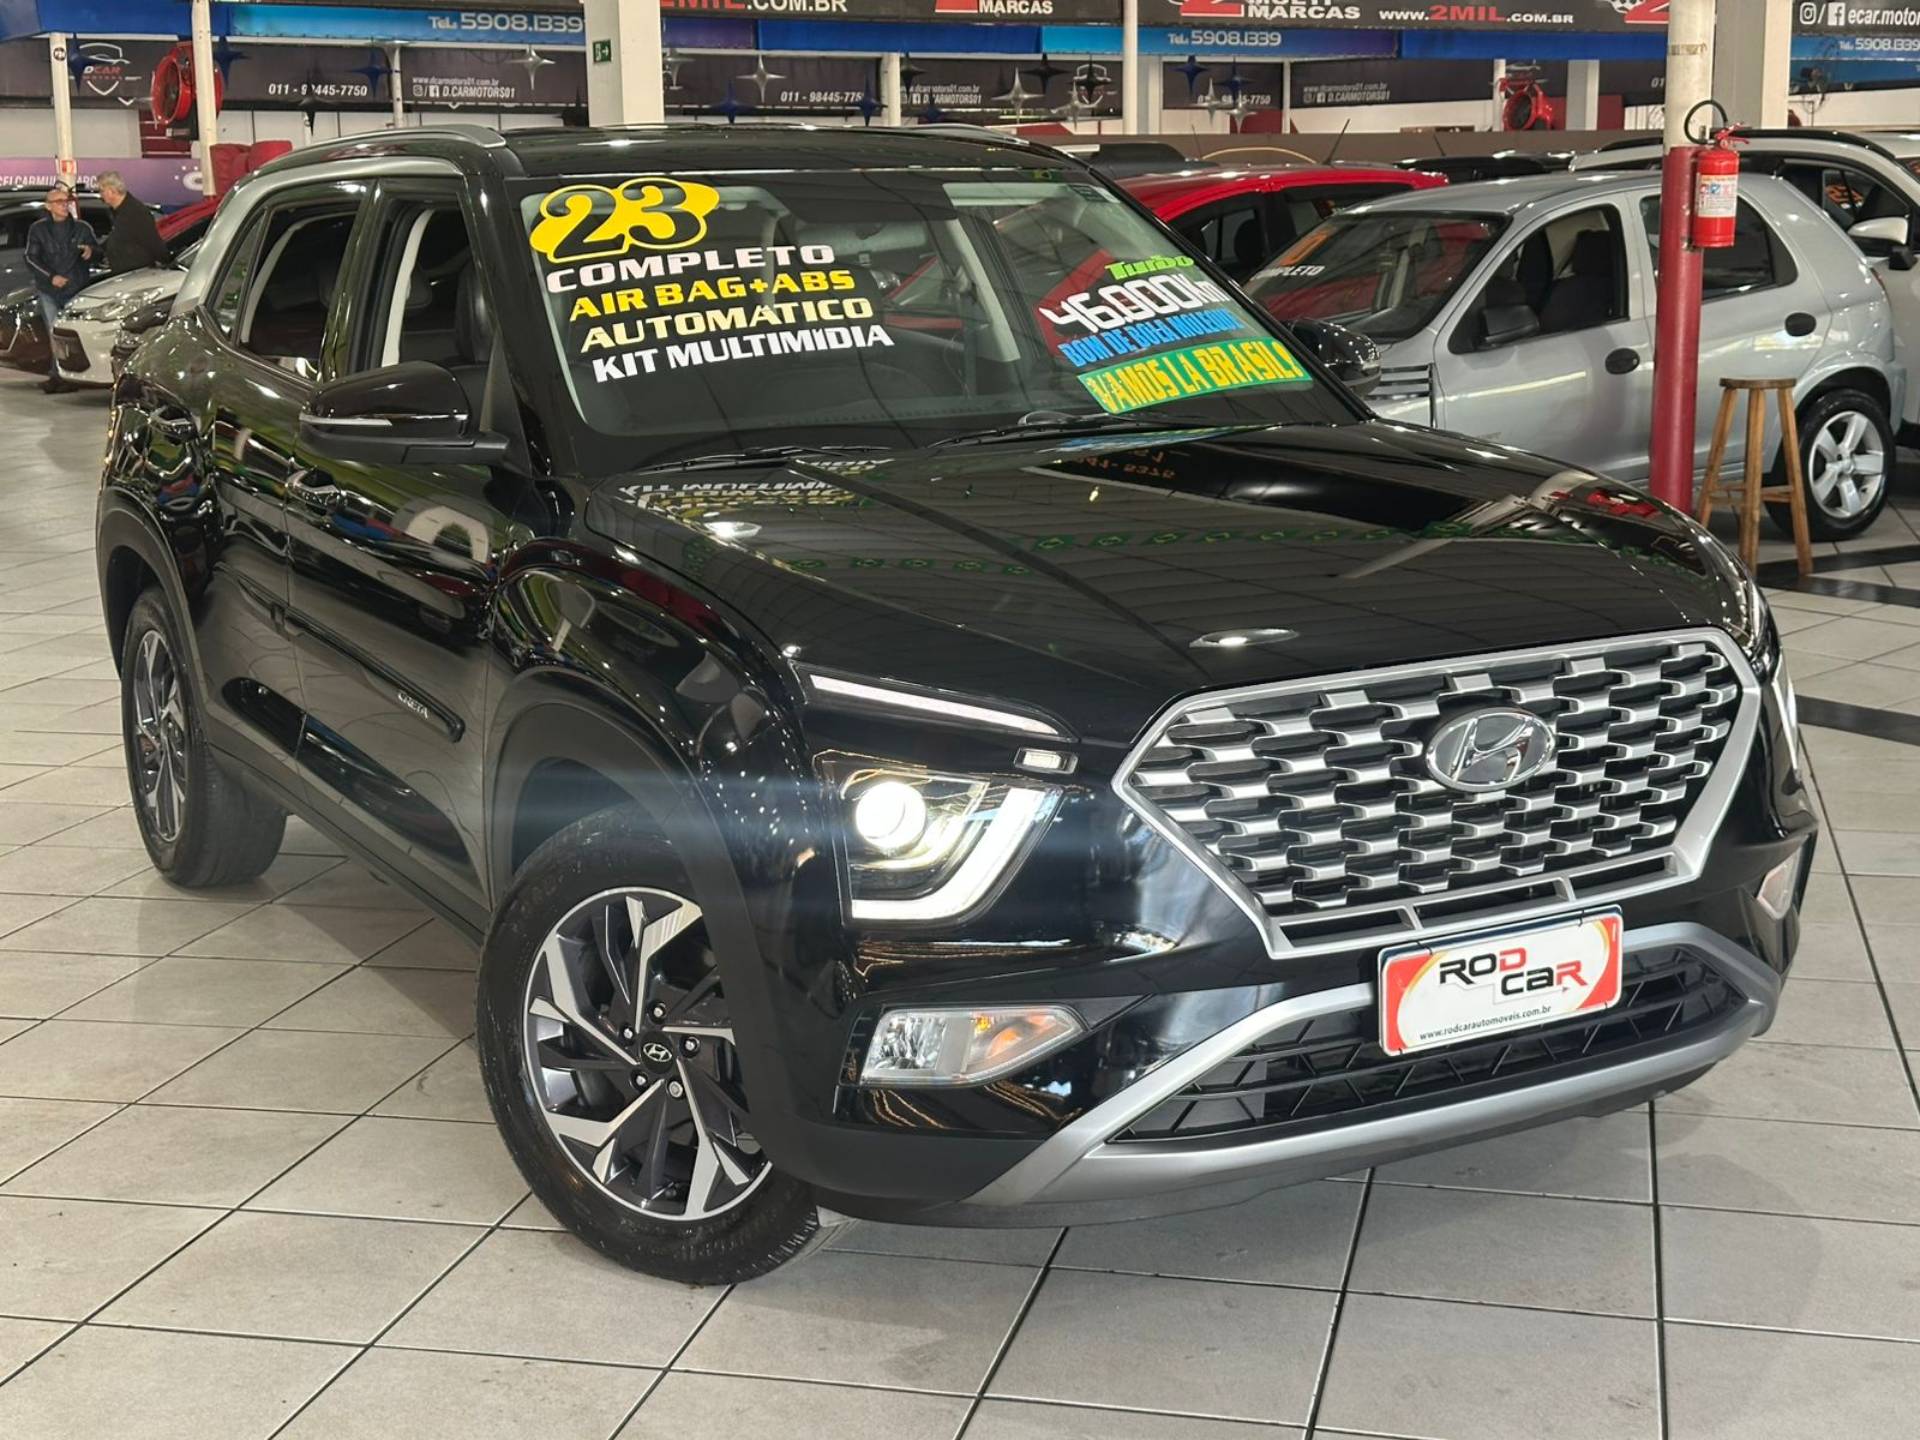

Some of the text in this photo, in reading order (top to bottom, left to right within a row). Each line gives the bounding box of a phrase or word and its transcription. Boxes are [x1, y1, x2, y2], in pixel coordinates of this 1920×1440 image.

[979, 0, 1053, 14] MARCAS
[1248, 6, 1361, 20] MARCAS
[460, 12, 584, 33] 5908.1339
[1191, 30, 1282, 46] 5908.1339
[268, 83, 289, 95] 011
[301, 83, 368, 96] 9445-7750
[442, 85, 515, 98] D.CARMOTORS01
[780, 90, 799, 102] 011
[809, 91, 865, 103] 98445-775
[530, 177, 719, 263] 23
[546, 244, 835, 293] COMPLETO
[1104, 254, 1194, 280] Turbo
[569, 269, 856, 322] AIR BAG+ABS
[1057, 334, 1115, 367] BOM
[1100, 328, 1139, 355] DE
[592, 349, 659, 383] KIT
[1086, 359, 1180, 414] VAMOS
[1191, 340, 1304, 388] BRASIL!
[1439, 947, 1527, 985] ROD
[1419, 1005, 1552, 1041] www.rodcarautomoveis.com.br
